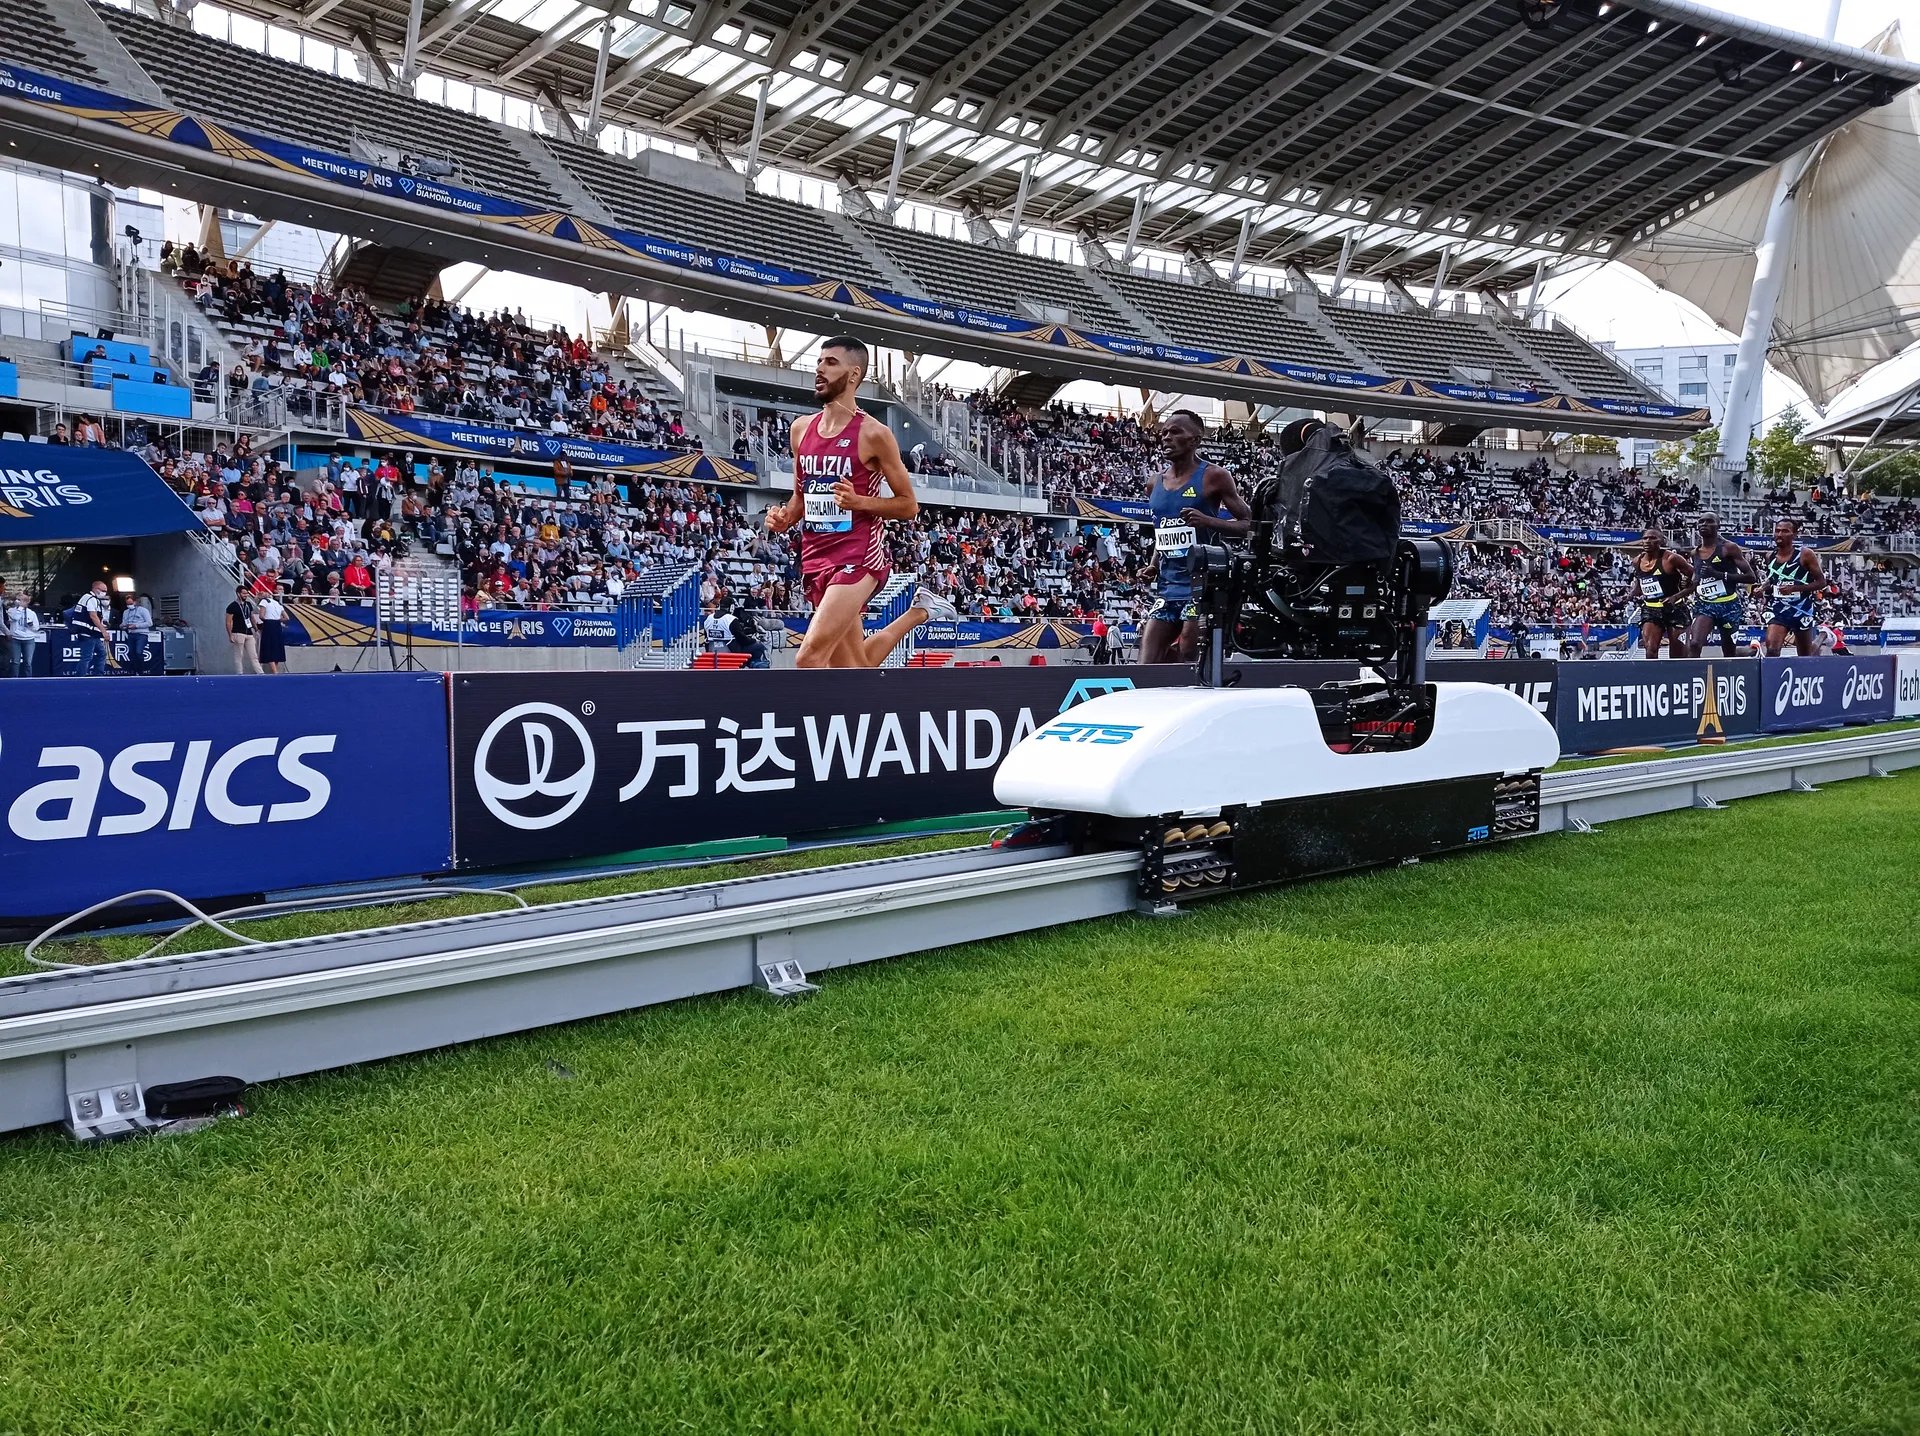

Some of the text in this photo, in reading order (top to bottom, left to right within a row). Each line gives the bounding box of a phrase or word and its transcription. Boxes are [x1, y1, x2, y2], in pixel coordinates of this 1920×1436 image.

[17, 81, 62, 101] LEAGUE
[302, 156, 393, 188] MEETING DE PARIS
[416, 189, 482, 212] DIAMOND LEAGUE
[646, 244, 680, 258] MEETING
[688, 253, 714, 268] PARIS
[730, 266, 757, 278] DIAMOND
[758, 273, 780, 283] LEAGUE
[902, 302, 929, 314] MEETING
[936, 308, 954, 320] PARIS
[968, 318, 1008, 330] DIAMOND LEAGUE
[1108, 342, 1131, 351] MEETING
[1136, 344, 1154, 356] PARIS
[452, 432, 496, 445] MEETING
[508, 436, 540, 454] PARIS
[596, 452, 624, 463] LEAGUE
[800, 455, 852, 476] POLIZIA
[0, 469, 61, 484] ING
[816, 482, 834, 492] asic
[0, 485, 93, 508] RIS
[1158, 532, 1193, 546] KIBIWOT
[1701, 584, 1718, 595] BETT
[490, 622, 501, 632] DE
[504, 618, 544, 639] PARIS
[572, 626, 616, 638] DIAMOND
[957, 632, 980, 640] LEAGUE
[62, 648, 81, 660] DE
[1578, 683, 1669, 723] MEETING
[1673, 682, 1690, 713] DE
[1692, 668, 1747, 728] PARIS
[1792, 672, 1884, 706] asics asics
[8, 734, 337, 841] asics
